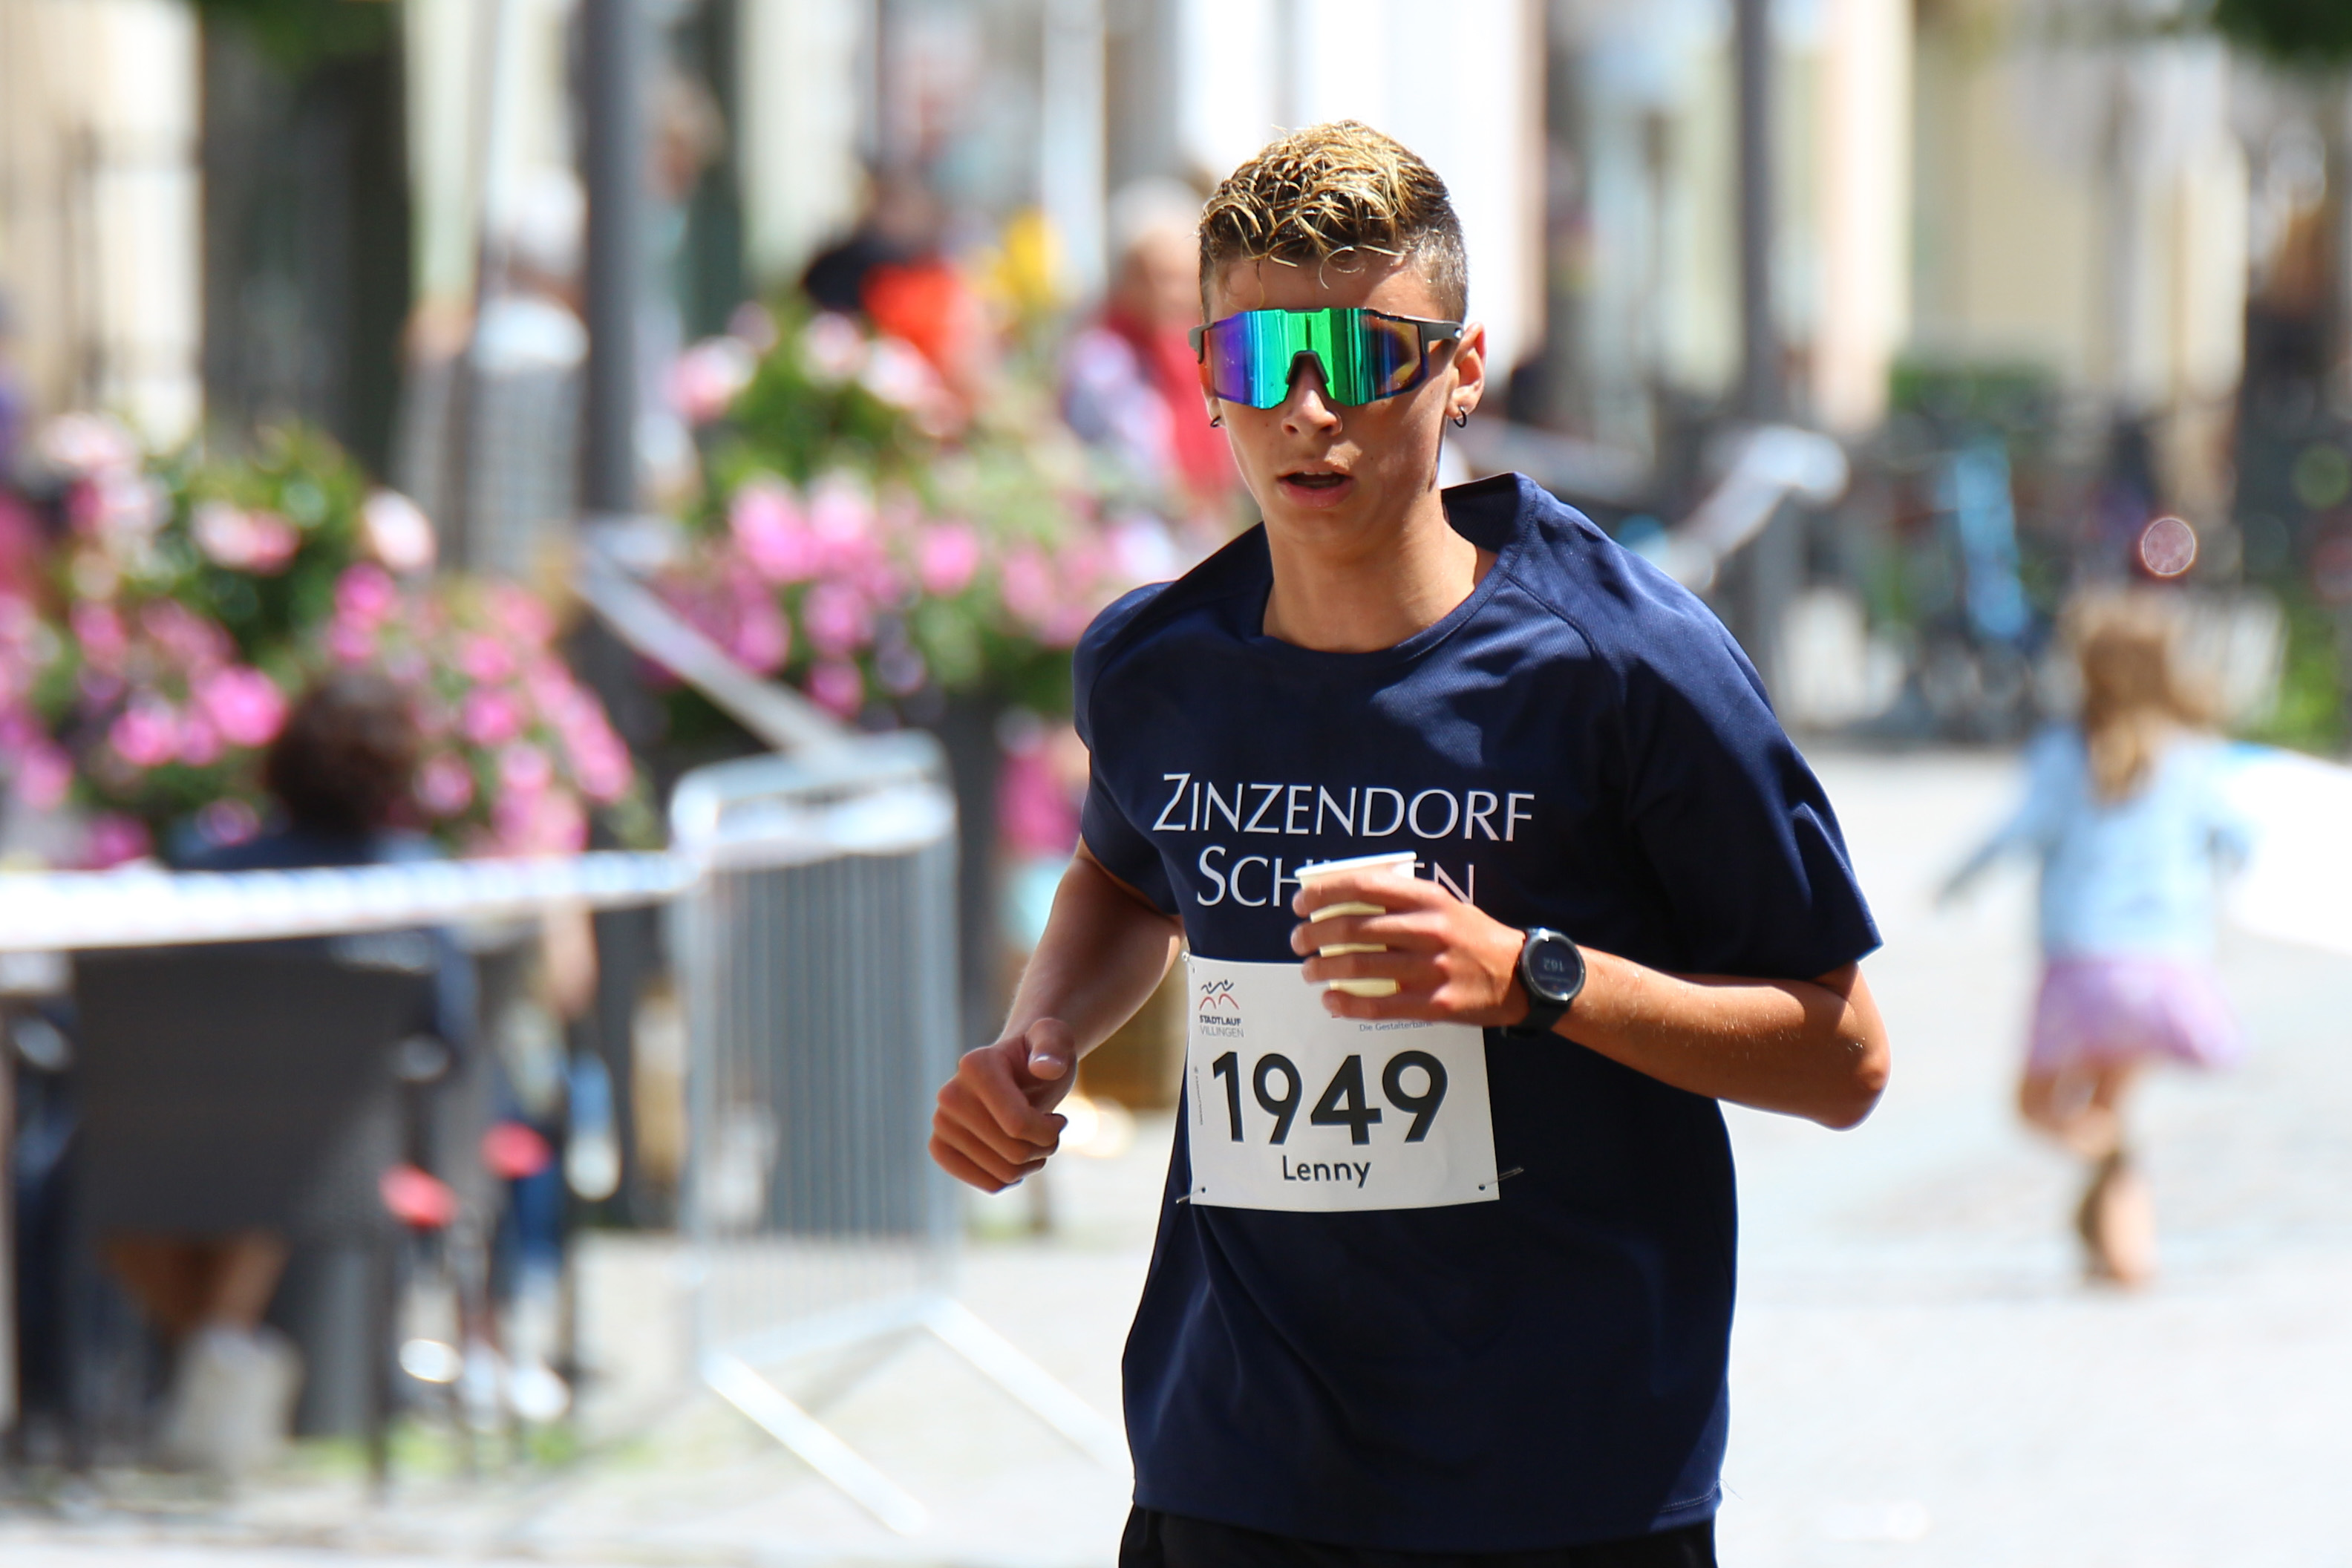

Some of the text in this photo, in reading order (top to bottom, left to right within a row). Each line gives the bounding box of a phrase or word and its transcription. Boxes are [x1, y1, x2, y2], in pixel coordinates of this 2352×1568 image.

[1152, 772, 1535, 842] ZINZENDORF
[1196, 845, 1474, 907] SCHN
[1199, 1014, 1241, 1027] STADTLAUF
[1200, 1025, 1244, 1039] VILLINGEN
[1359, 1024, 1373, 1032] Die
[1212, 1050, 1448, 1146] 1949
[1282, 1154, 1372, 1189] Lenny
